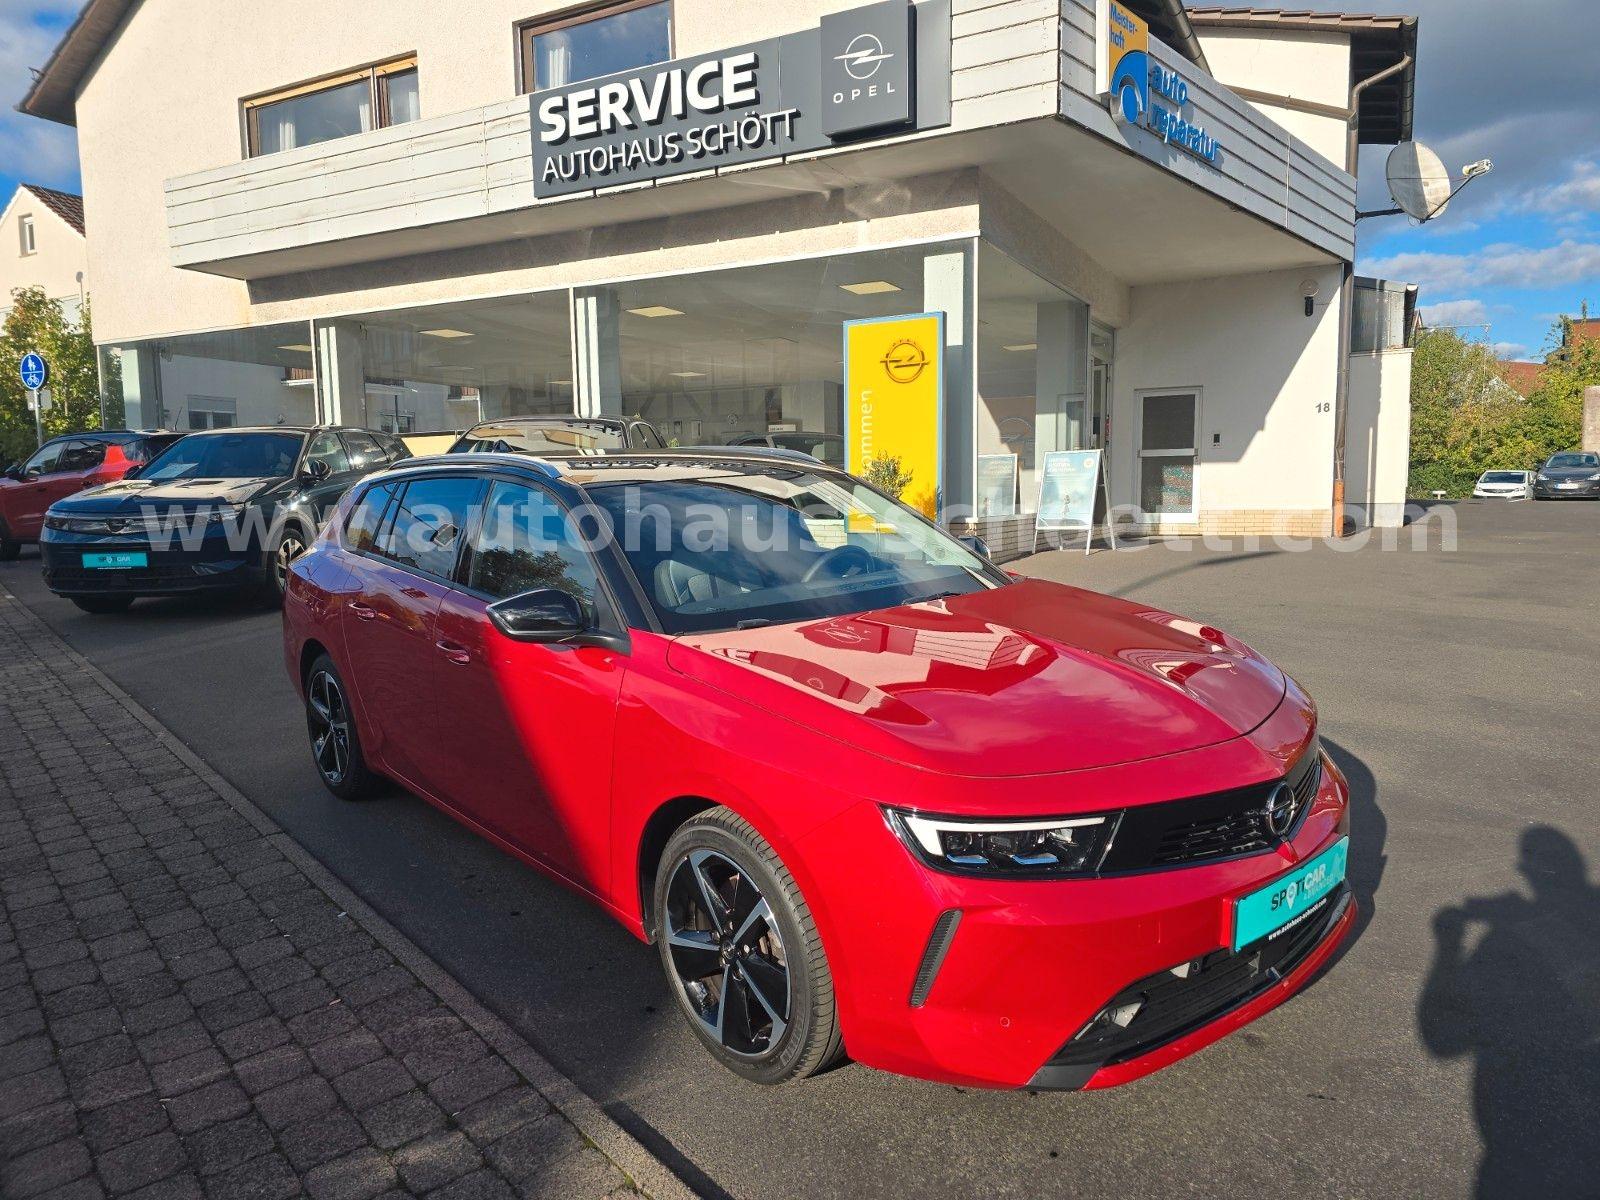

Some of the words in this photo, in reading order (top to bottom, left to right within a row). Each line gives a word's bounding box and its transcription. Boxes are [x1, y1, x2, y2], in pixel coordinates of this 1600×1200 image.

[538, 52, 757, 142] SERVICE
[833, 82, 895, 104] OPEL
[1150, 65, 1189, 106] auto
[541, 134, 679, 183] AUTOHAUS
[687, 108, 797, 155] SCHÖTT
[861, 390, 873, 468] ommen
[1315, 401, 1330, 414] 18
